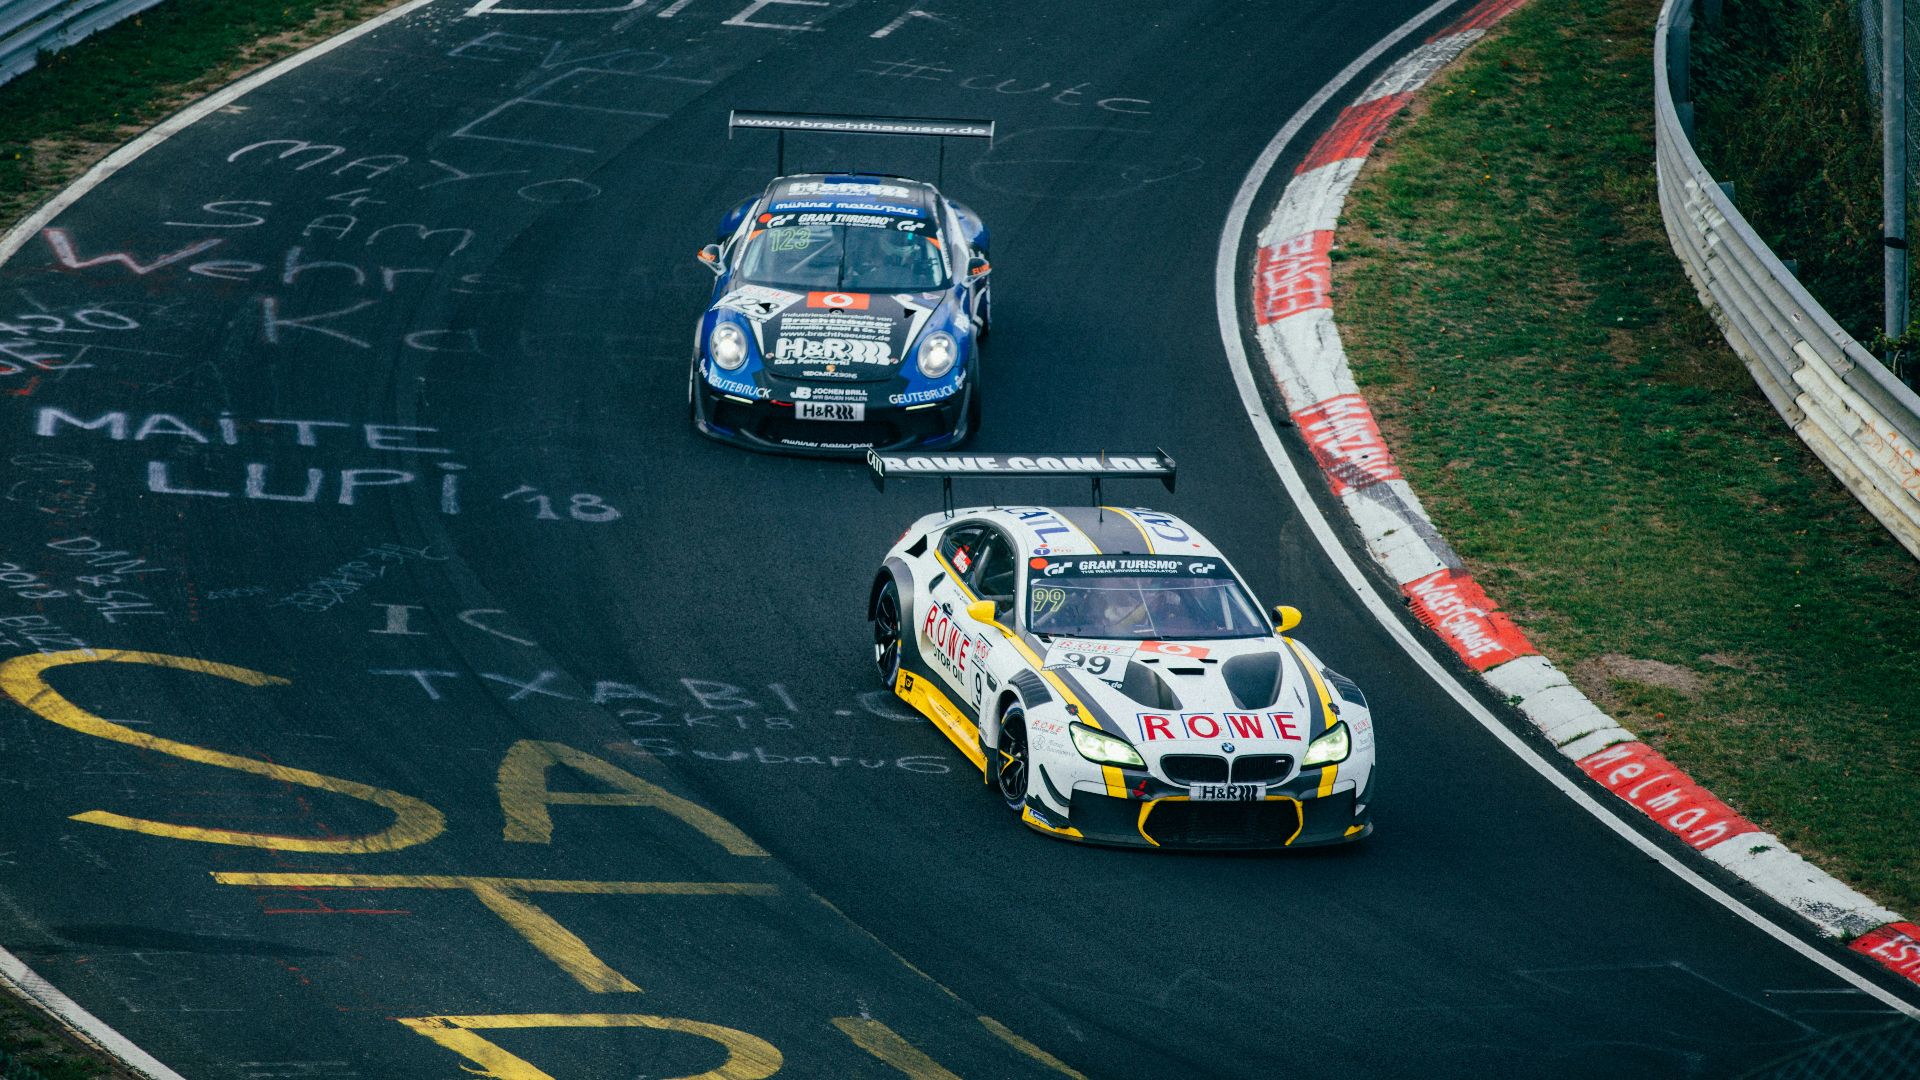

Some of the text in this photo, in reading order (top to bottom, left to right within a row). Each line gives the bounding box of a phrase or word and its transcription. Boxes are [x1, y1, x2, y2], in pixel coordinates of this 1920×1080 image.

[738, 118, 987, 135] www.brachthaeuser.de
[798, 213, 834, 224] GRAN
[836, 203, 919, 216] motorsport
[769, 229, 811, 252] 123
[779, 330, 891, 342] www.brachthaeuser.de
[867, 450, 884, 477] CATL
[1079, 560, 1118, 571] GRAN
[1032, 588, 1066, 613] 99
[924, 605, 969, 671] ROWE
[1063, 652, 1112, 676] 99
[952, 666, 965, 686] OIL
[1142, 713, 1303, 742] ROWE
